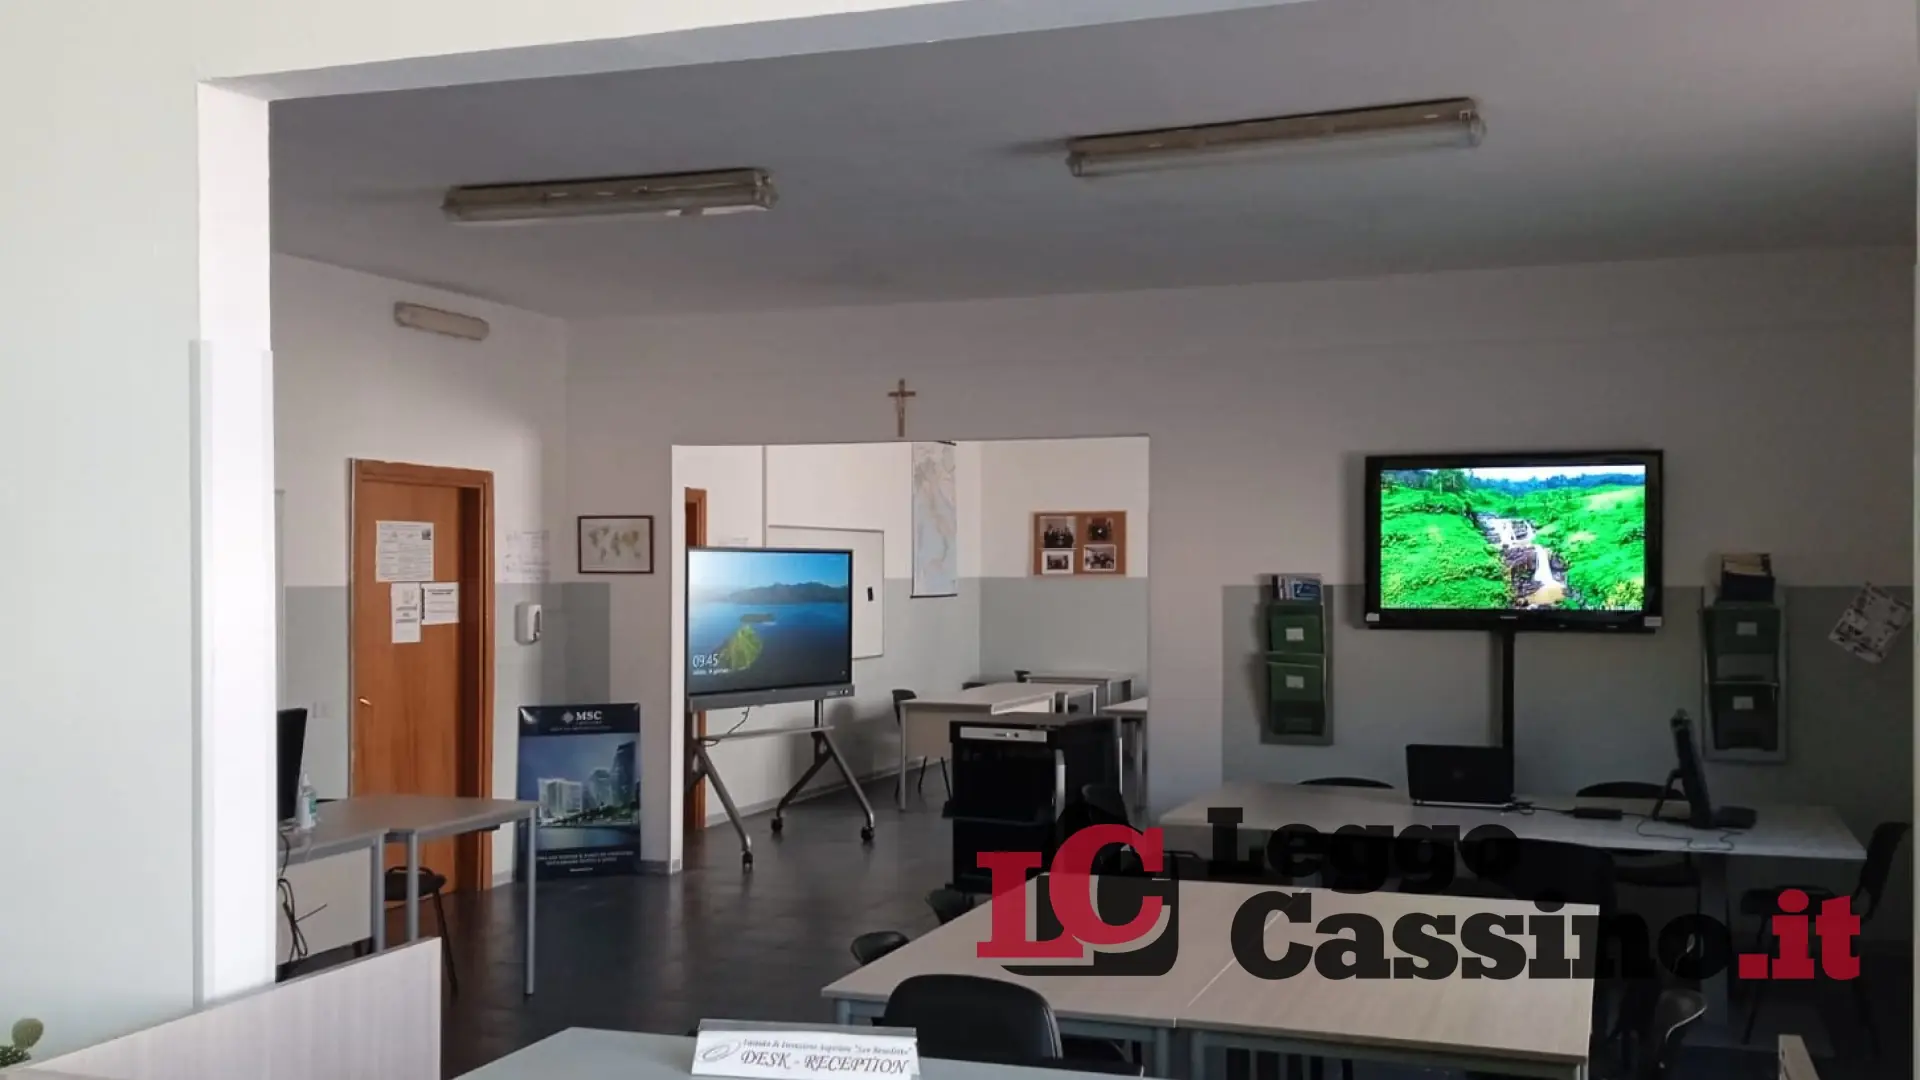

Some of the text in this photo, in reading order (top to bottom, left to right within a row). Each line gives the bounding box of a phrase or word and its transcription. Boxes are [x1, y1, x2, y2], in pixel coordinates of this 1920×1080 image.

[575, 710, 603, 721] MSC
[741, 1050, 791, 1070] DESK
[804, 1054, 909, 1075] RECEPTION
